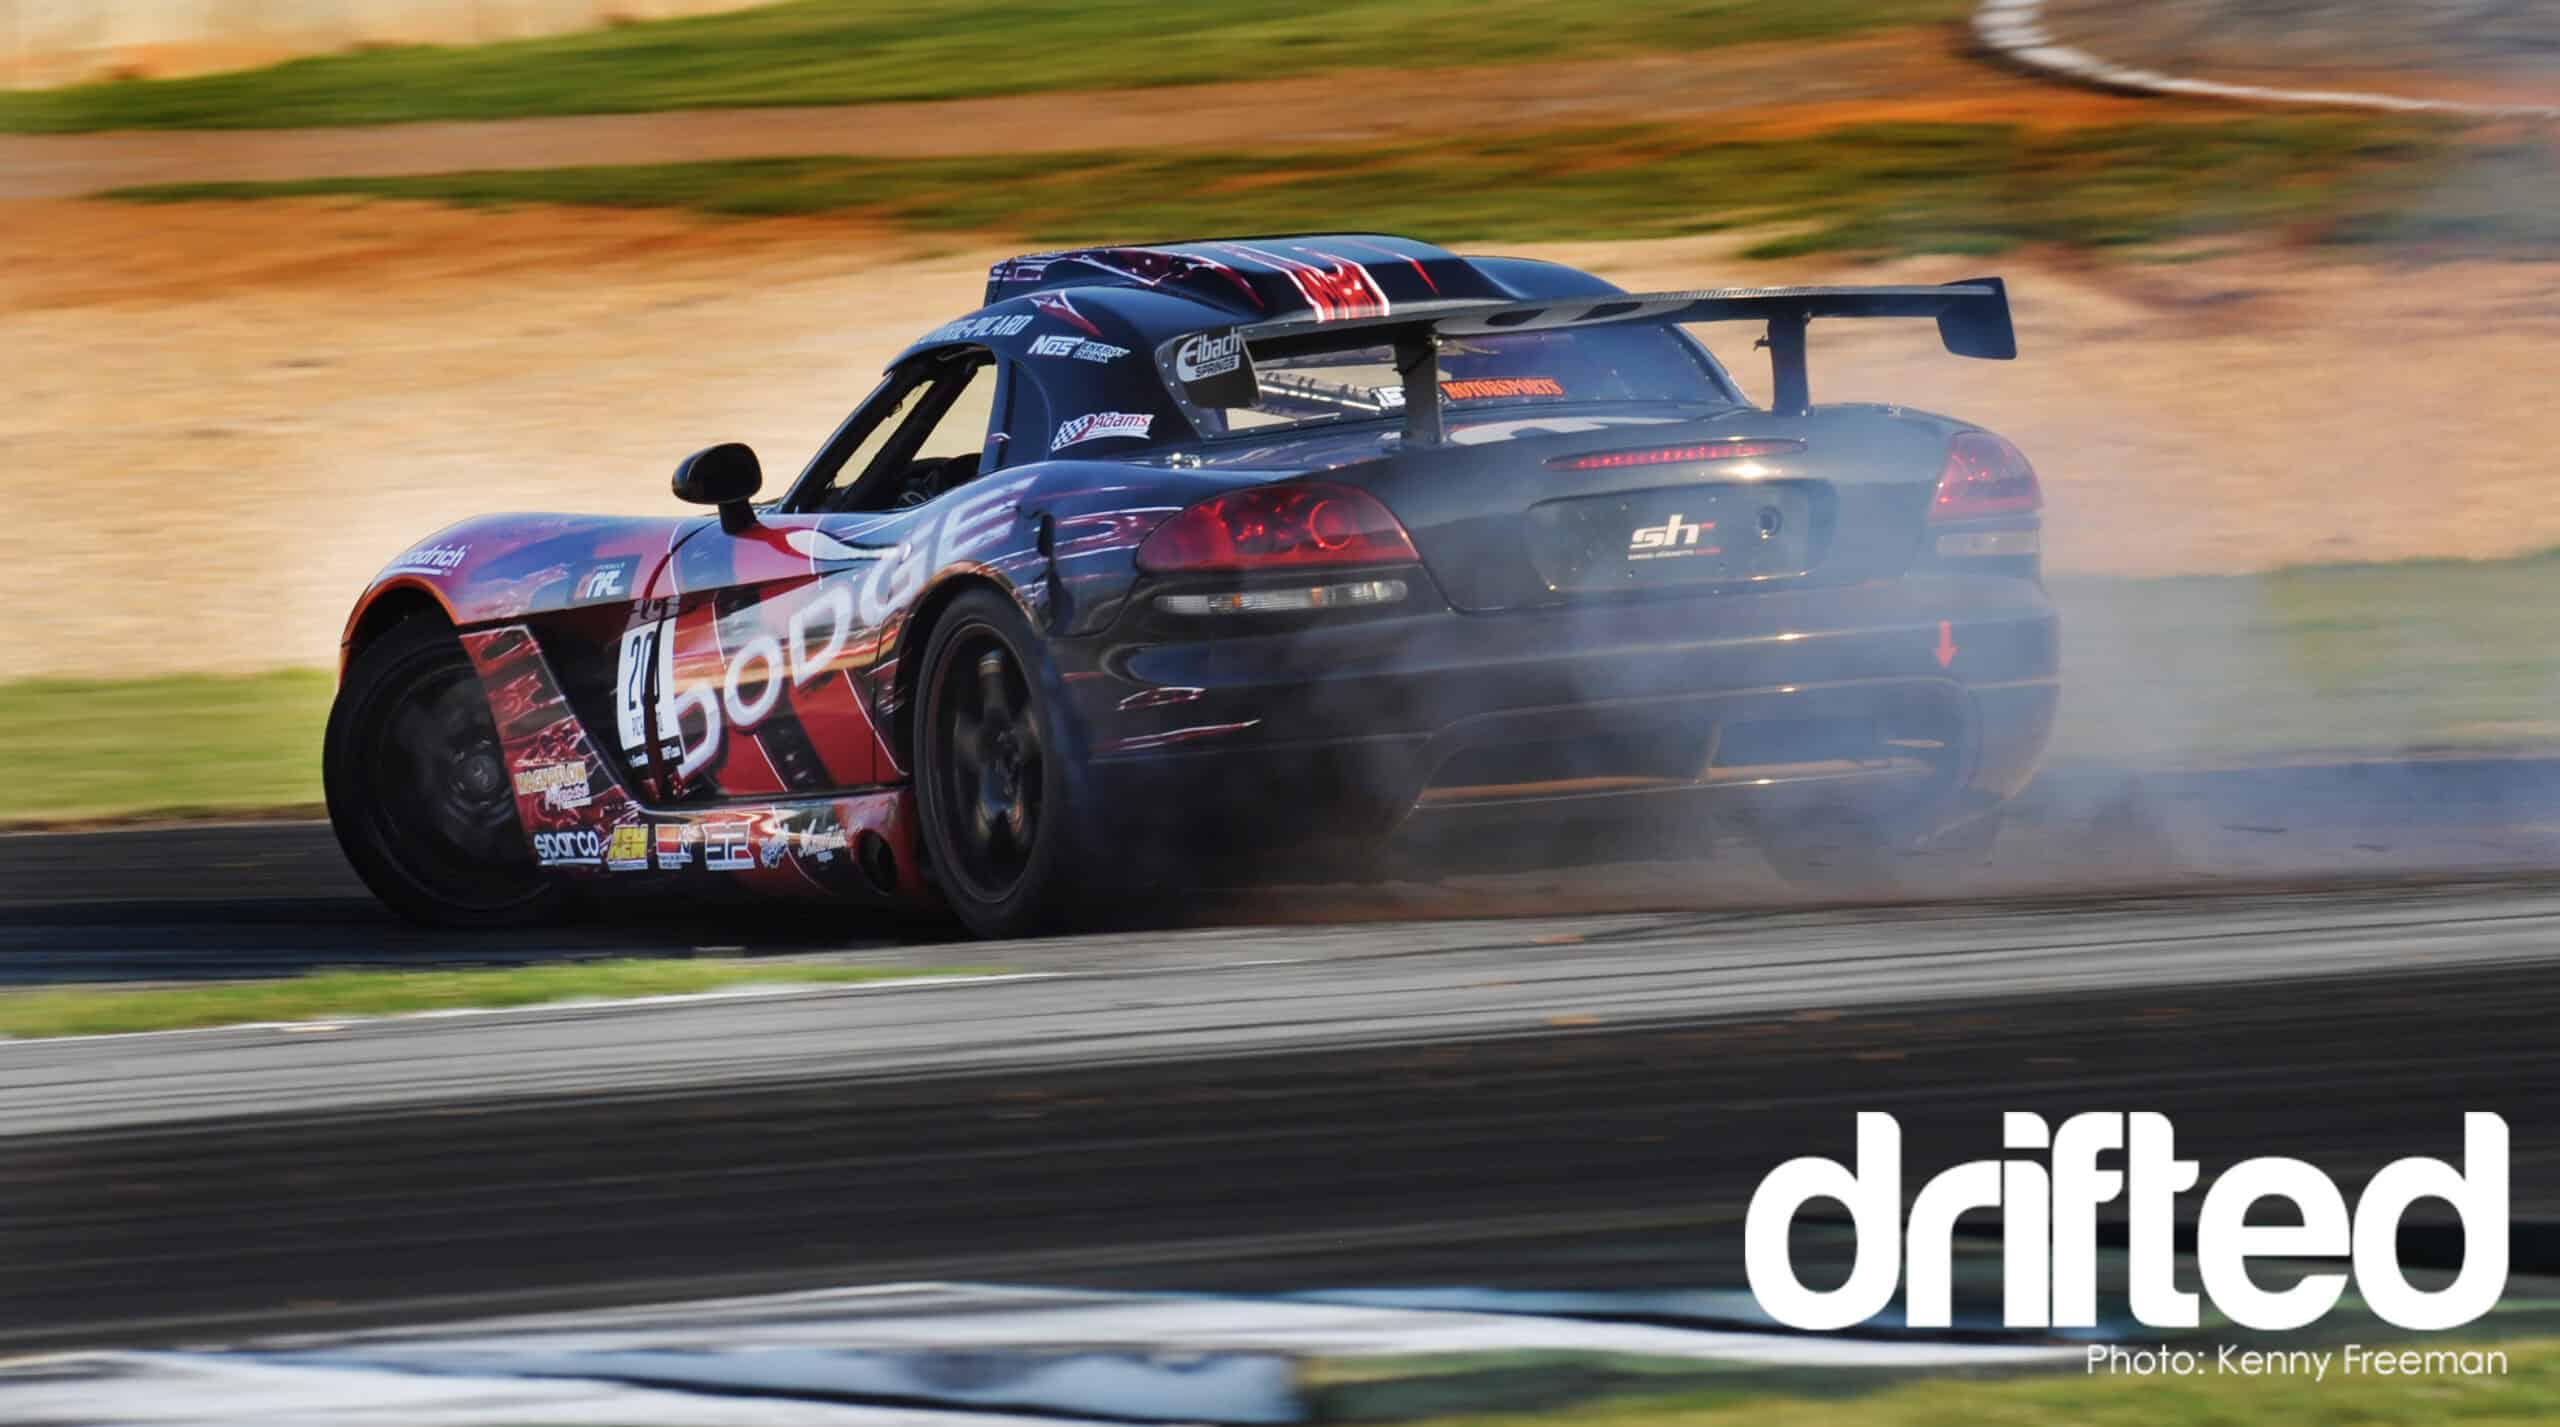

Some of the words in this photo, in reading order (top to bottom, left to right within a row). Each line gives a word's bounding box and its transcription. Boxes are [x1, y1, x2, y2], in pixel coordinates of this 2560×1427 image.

[1027, 335, 1085, 356] NOS
[1177, 326, 1240, 381] Eibach
[1441, 379, 1564, 400] MOTORSPORTS
[1094, 415, 1148, 428] Adams
[674, 474, 1040, 779] DODGE
[534, 830, 600, 862] sparco
